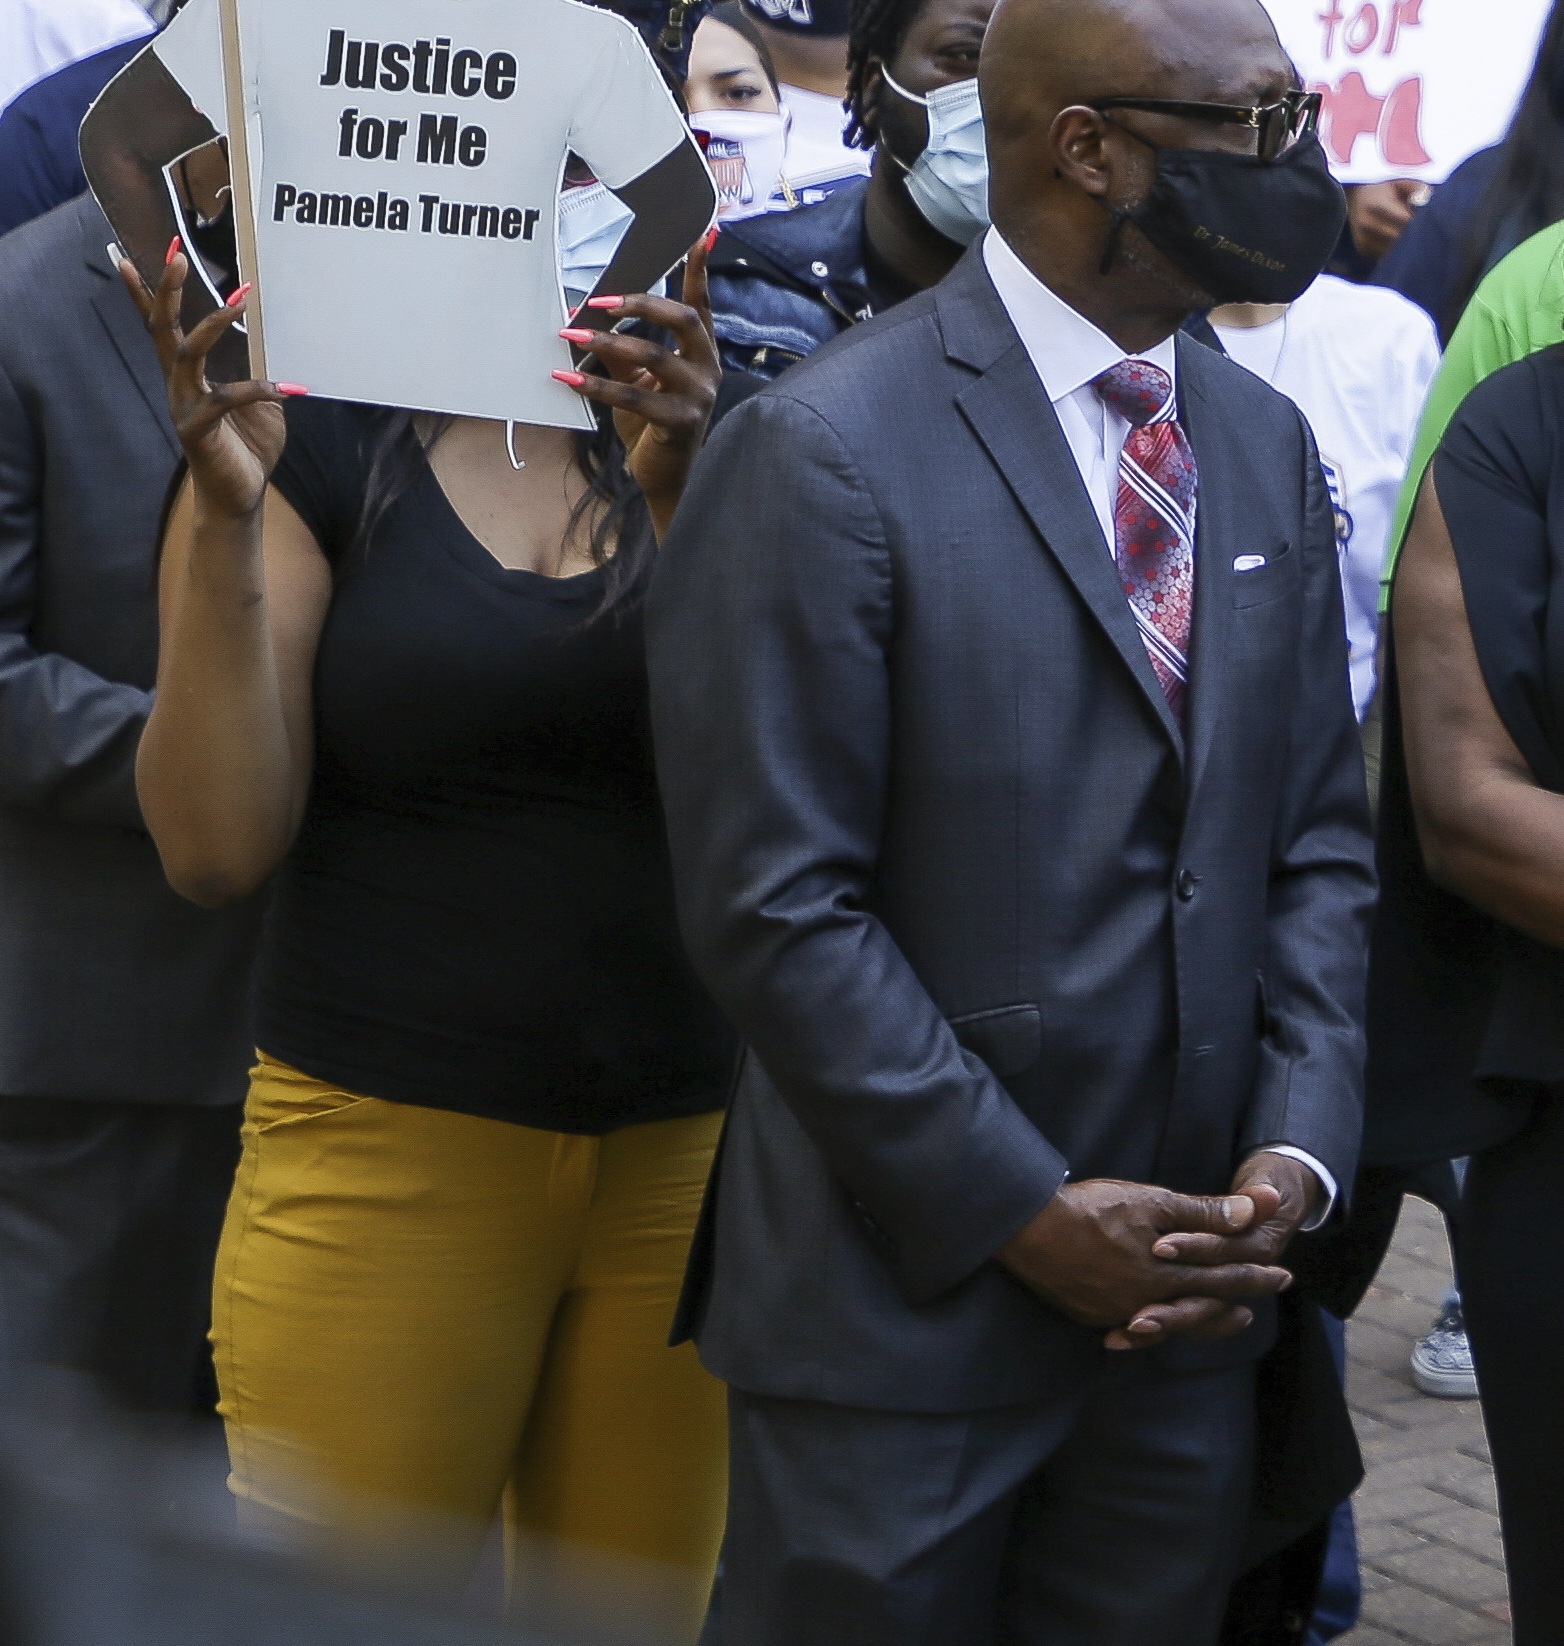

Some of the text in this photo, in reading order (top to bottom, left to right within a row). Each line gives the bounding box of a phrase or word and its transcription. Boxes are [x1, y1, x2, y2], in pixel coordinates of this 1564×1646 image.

[320, 28, 518, 101] Justice
[338, 106, 487, 168] for Me
[272, 183, 541, 242] Pamela Turner
